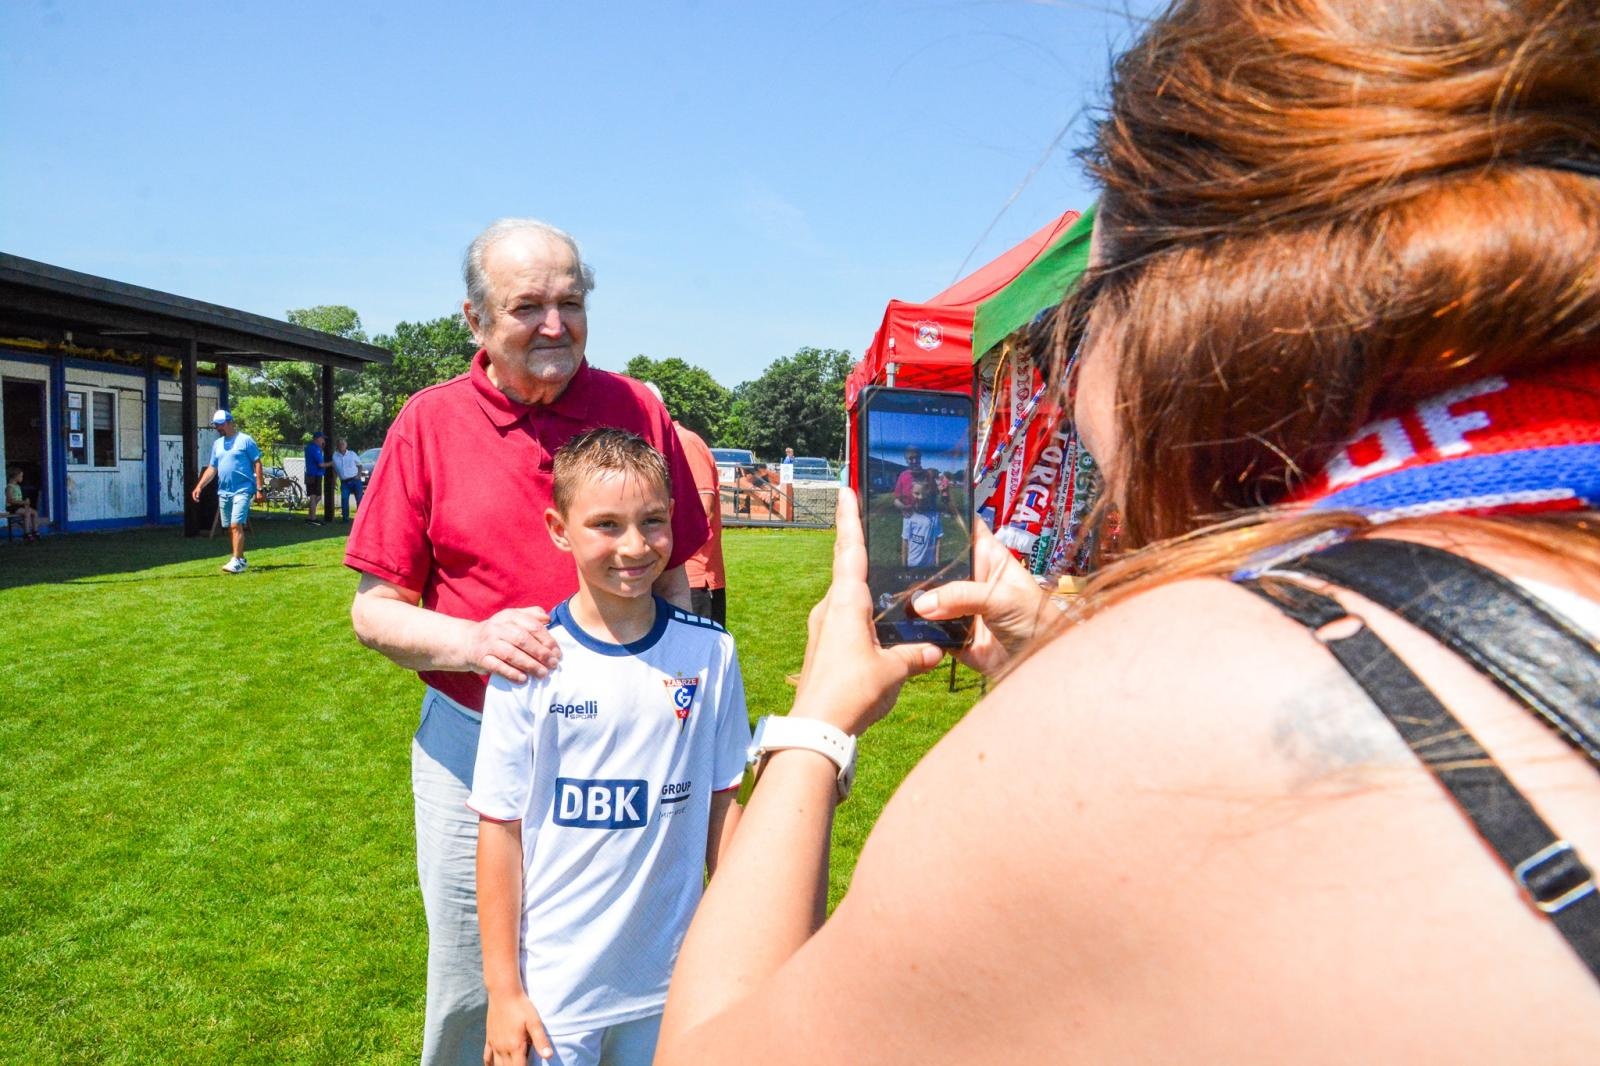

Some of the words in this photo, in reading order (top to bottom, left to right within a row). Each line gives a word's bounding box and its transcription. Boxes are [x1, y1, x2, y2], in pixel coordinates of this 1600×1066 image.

[665, 679, 697, 687] ZABRZE
[549, 700, 597, 718] capelli
[559, 784, 640, 822] DBK
[661, 781, 692, 795] GROUP
